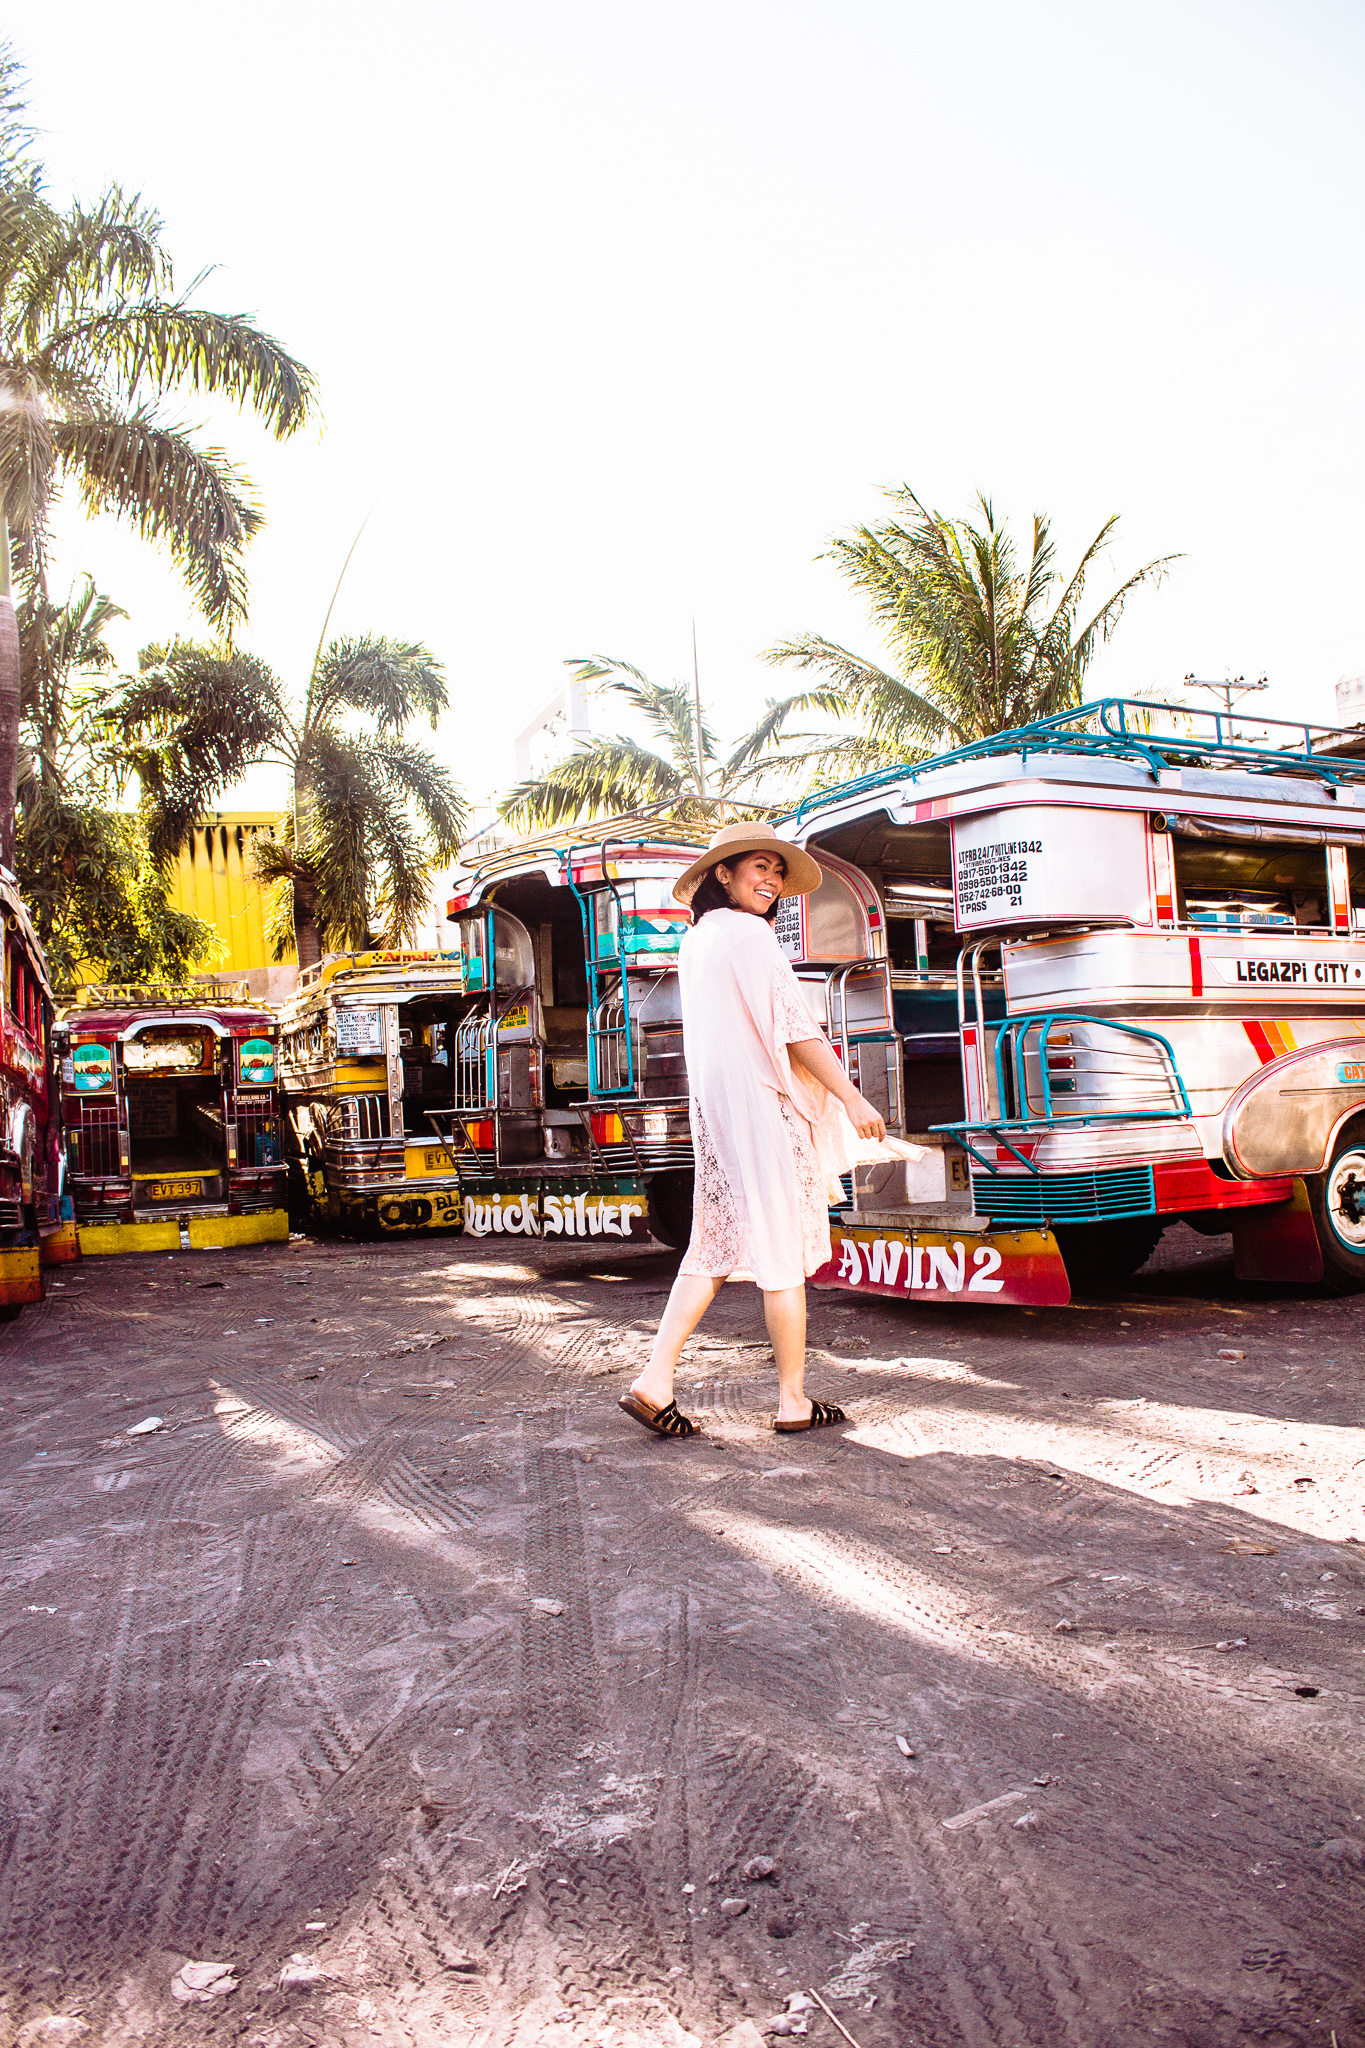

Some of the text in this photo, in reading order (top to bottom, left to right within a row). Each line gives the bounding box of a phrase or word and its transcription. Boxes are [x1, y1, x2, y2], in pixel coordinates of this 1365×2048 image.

[959, 848, 977, 864] LTFRB
[978, 845, 995, 860] 24/7
[1018, 841, 1043, 854] 1342
[959, 861, 1027, 880] 0917-550-1342
[959, 872, 1028, 891] 0998-550-1342
[959, 884, 1021, 903] 052-742-68-00
[1010, 896, 1022, 906] 21
[1315, 963, 1349, 983] CiTY
[427, 1153, 447, 1164] EVT
[152, 1183, 199, 1196] EVT 397
